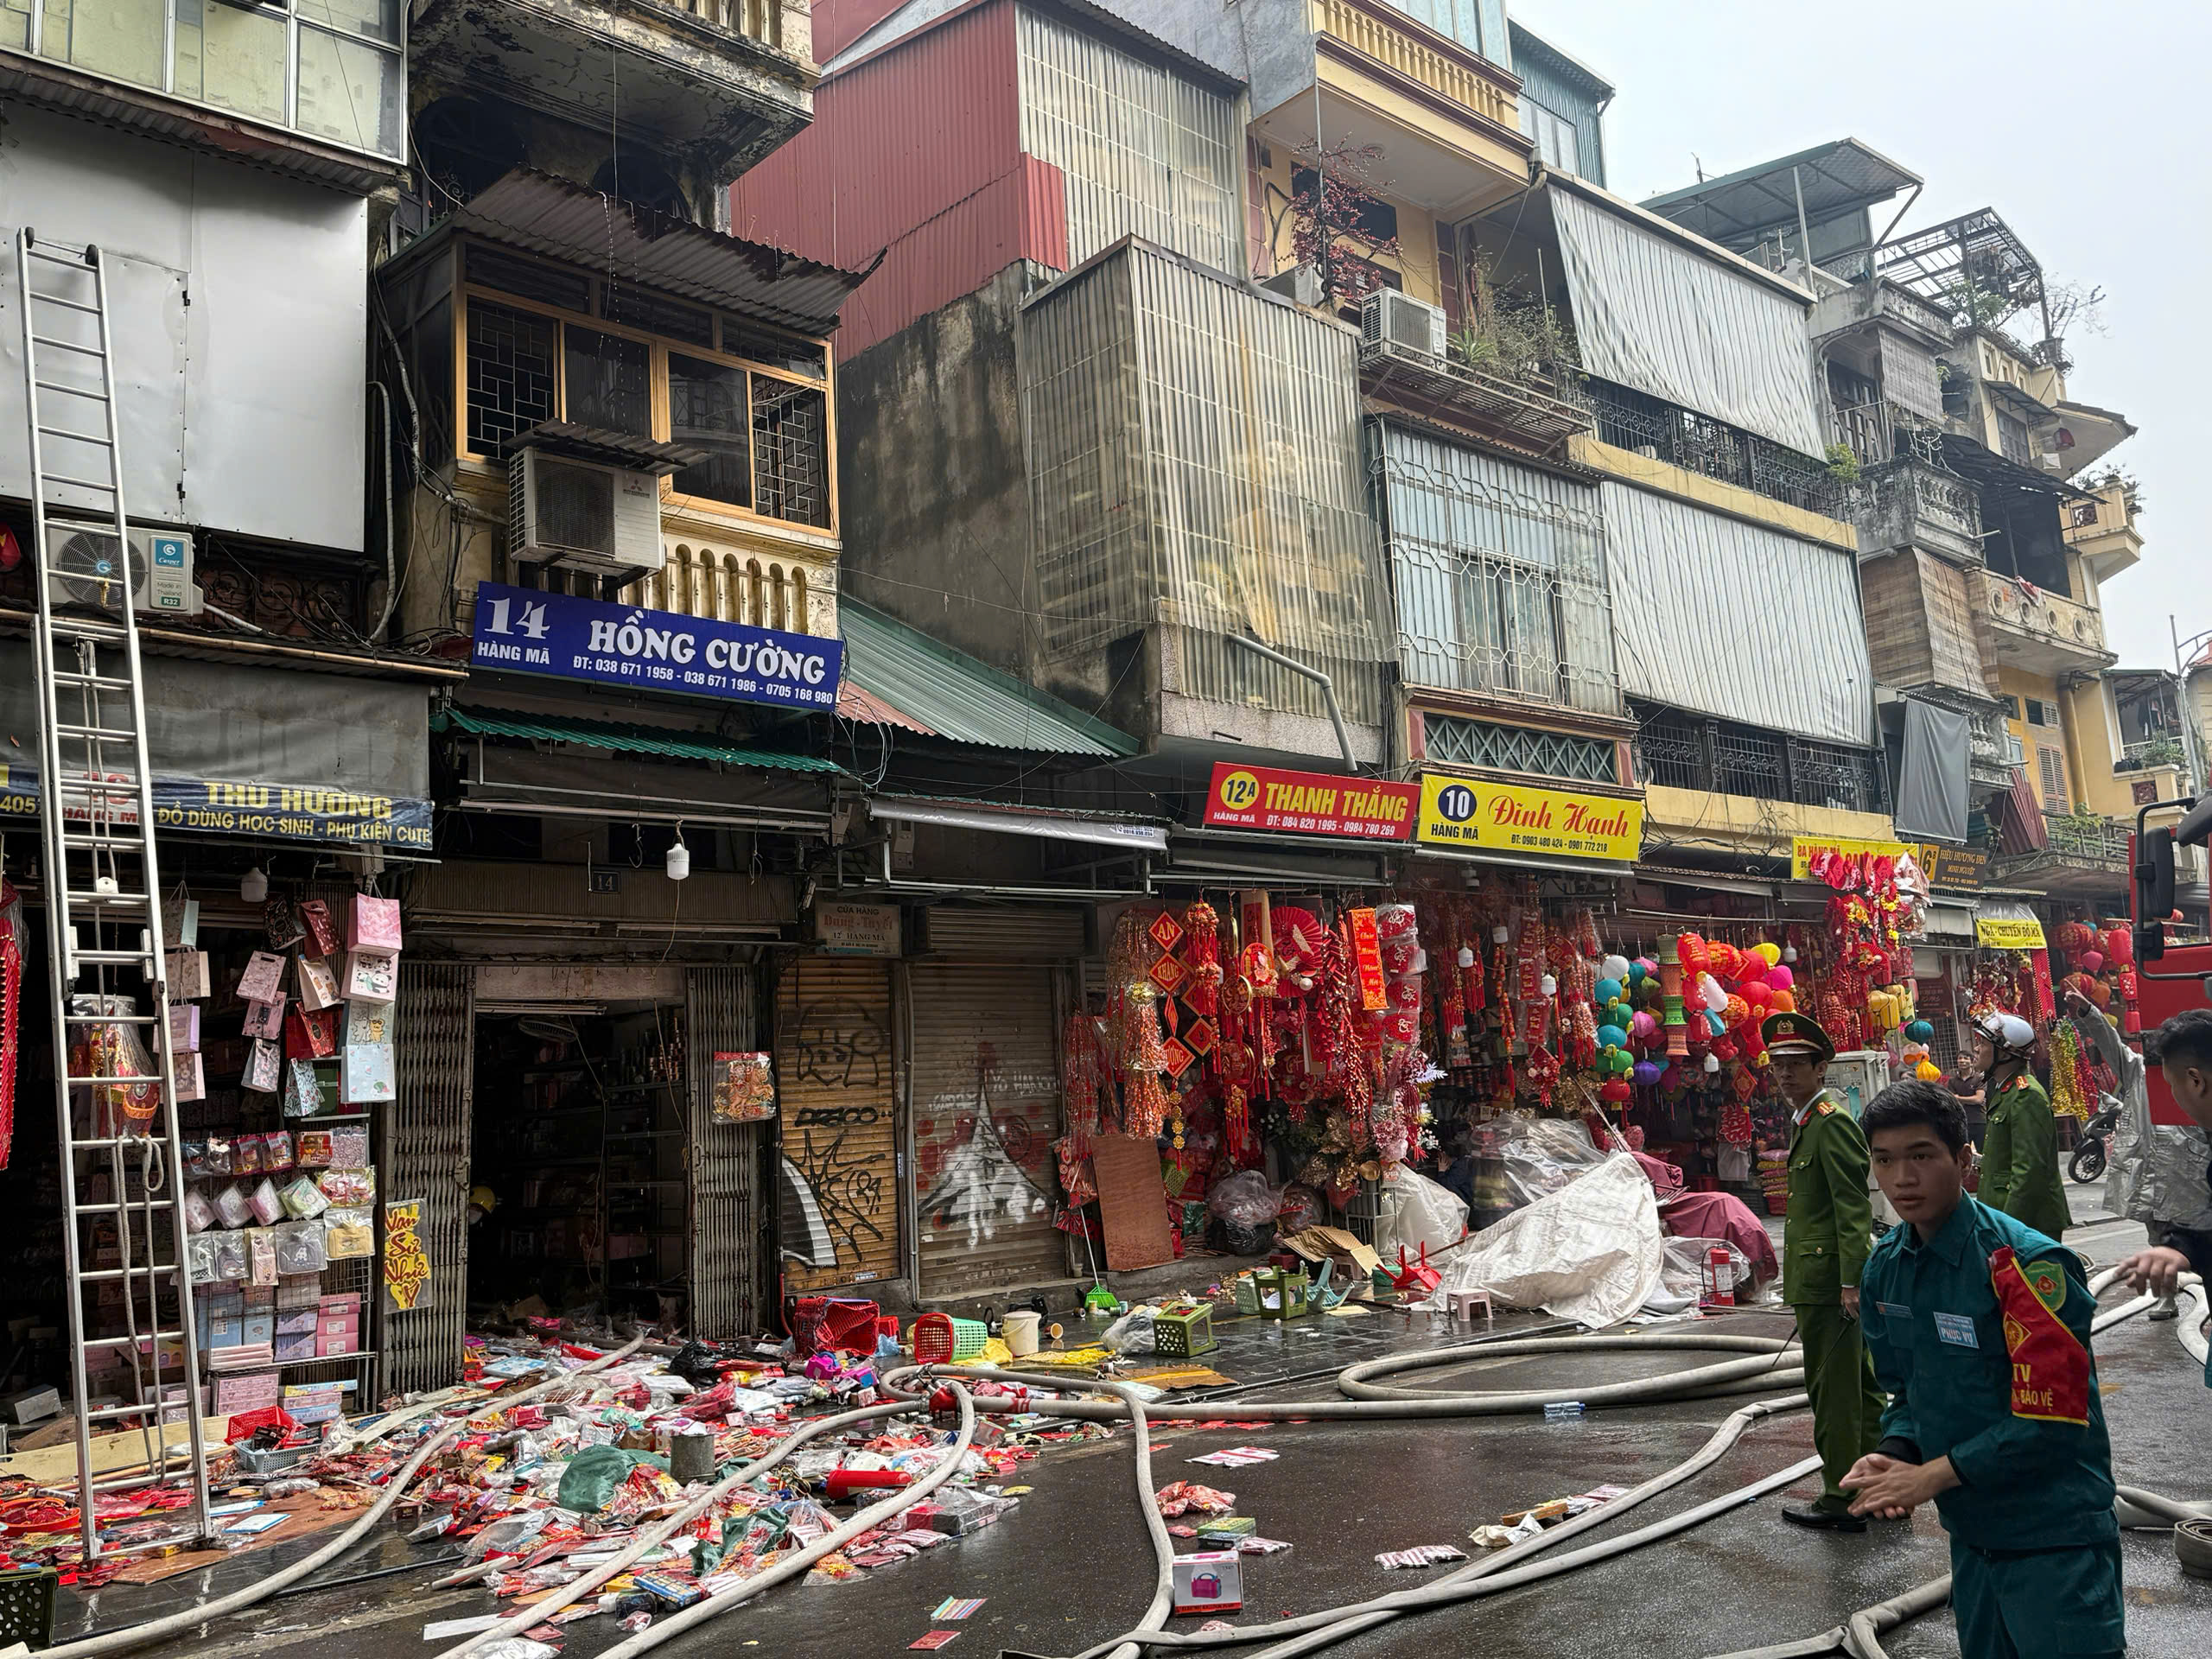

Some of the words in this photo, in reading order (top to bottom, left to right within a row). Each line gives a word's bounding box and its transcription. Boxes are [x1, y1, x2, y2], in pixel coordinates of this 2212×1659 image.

[163, 597, 179, 606] R32
[484, 597, 551, 639] 14
[477, 640, 522, 661] HÀNG
[525, 647, 550, 664] MÃ
[587, 609, 696, 664] HỒNG
[705, 639, 826, 684] CƯỜNG
[573, 655, 592, 671] ĐT:
[595, 658, 618, 673] 038
[620, 662, 641, 677] 671
[646, 665, 674, 681] 1958
[683, 671, 705, 685] 038
[707, 674, 727, 689] 671
[731, 677, 757, 692] 1986
[766, 683, 791, 698] 0705
[794, 688, 812, 702] 168
[814, 690, 833, 704] 980
[1226, 779, 1256, 803] 12A
[0, 795, 41, 814] 405
[1265, 782, 1338, 815] THANH
[1342, 785, 1408, 822] THẮNG
[1446, 790, 1470, 818] 10
[120, 812, 138, 823] M
[188, 805, 235, 830] DÙNG
[279, 817, 315, 836] SINH
[1213, 811, 1238, 822] HÀNG
[1241, 814, 1255, 823] MÃ
[1282, 816, 1298, 828] 084
[1299, 817, 1315, 830] 820
[1318, 819, 1338, 830] 1995
[1344, 821, 1363, 833] 0984
[1364, 823, 1379, 836] 780
[1380, 825, 1395, 836] 269
[1562, 802, 1630, 841] Hạnh
[1431, 823, 1459, 838] HÀNG
[1462, 826, 1479, 840] MÃ
[1522, 835, 1538, 846] 0903
[1539, 836, 1550, 847] 480
[1552, 838, 1562, 848] 424
[1568, 840, 1582, 850] 0901
[1584, 841, 1595, 851] 772
[1596, 842, 1607, 853] 218
[596, 874, 614, 891] 14
[856, 906, 880, 916] HÀNG
[1157, 921, 1175, 941] AN
[1157, 961, 1179, 982] KHANG
[2012, 1363, 2031, 1382] TV
[2020, 1383, 2038, 1406] BẢO
[2040, 1388, 2054, 1412] VỆ
